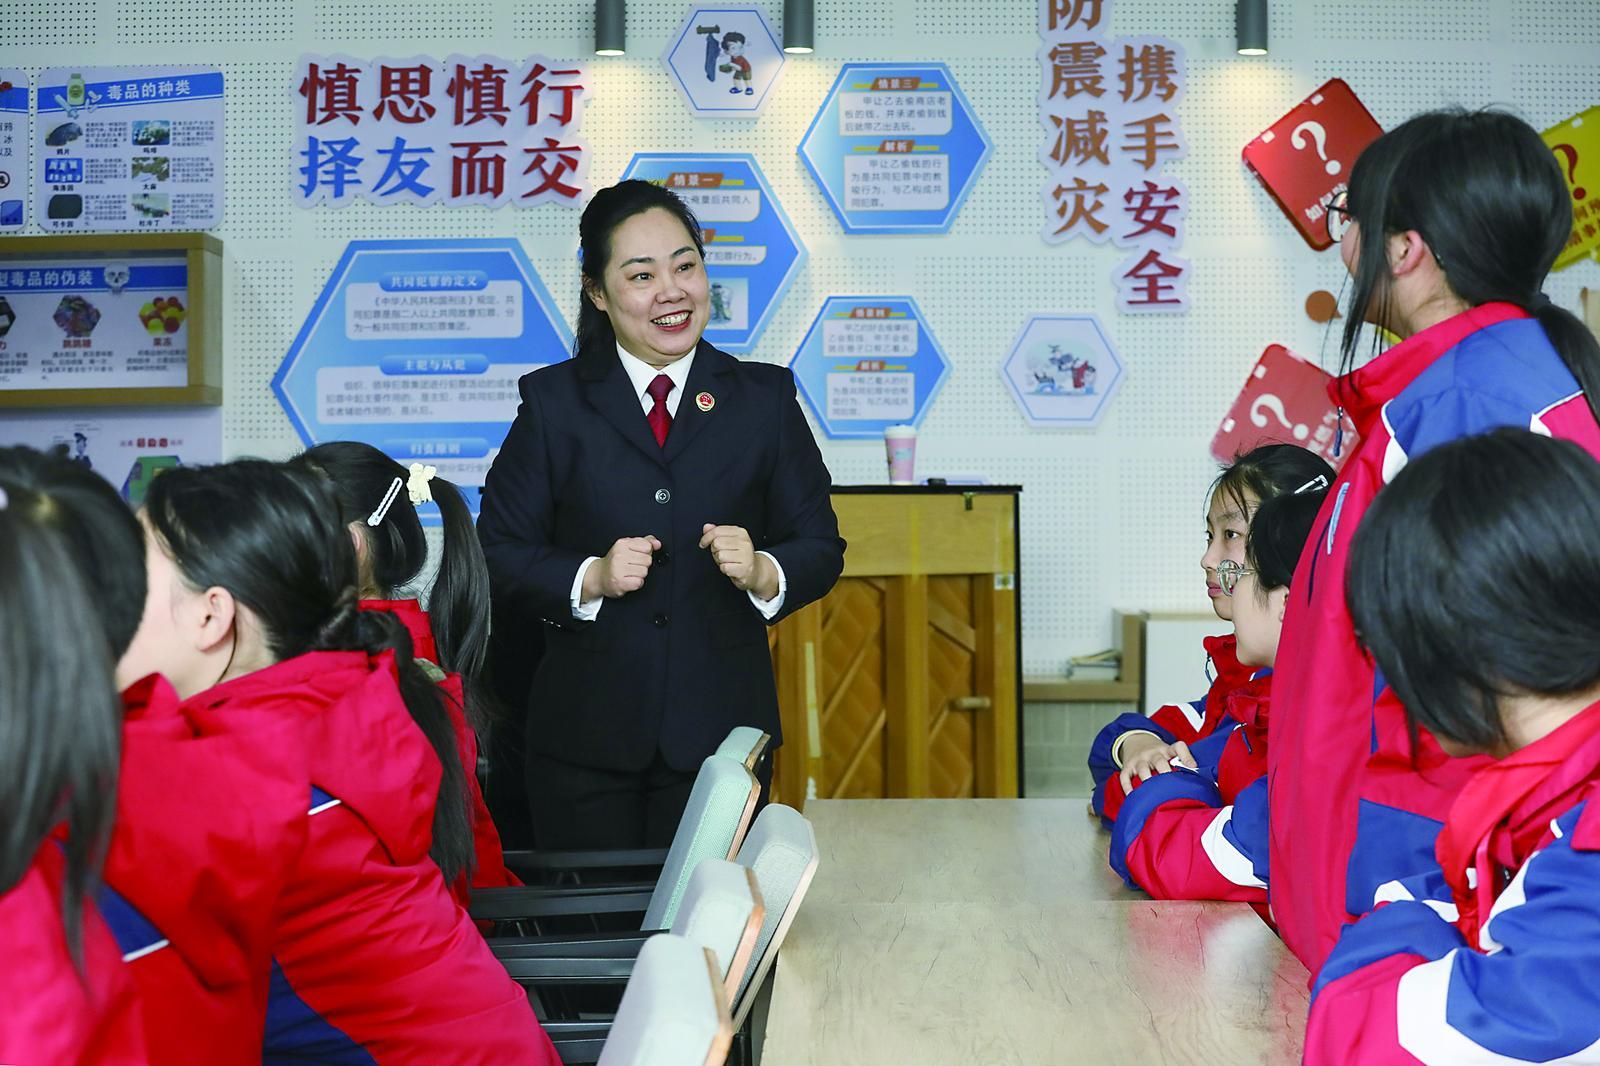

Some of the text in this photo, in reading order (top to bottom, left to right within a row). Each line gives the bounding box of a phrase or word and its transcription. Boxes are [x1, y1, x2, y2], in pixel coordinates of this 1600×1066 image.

[107, 80, 191, 100] 毒品的种类
[299, 62, 584, 127] 慎思慎行
[299, 136, 583, 199] 择友而交
[1117, 44, 1184, 306] 携手安全
[391, 274, 477, 288] 共同犯罪的定义
[404, 359, 466, 371] 主犯与从犯
